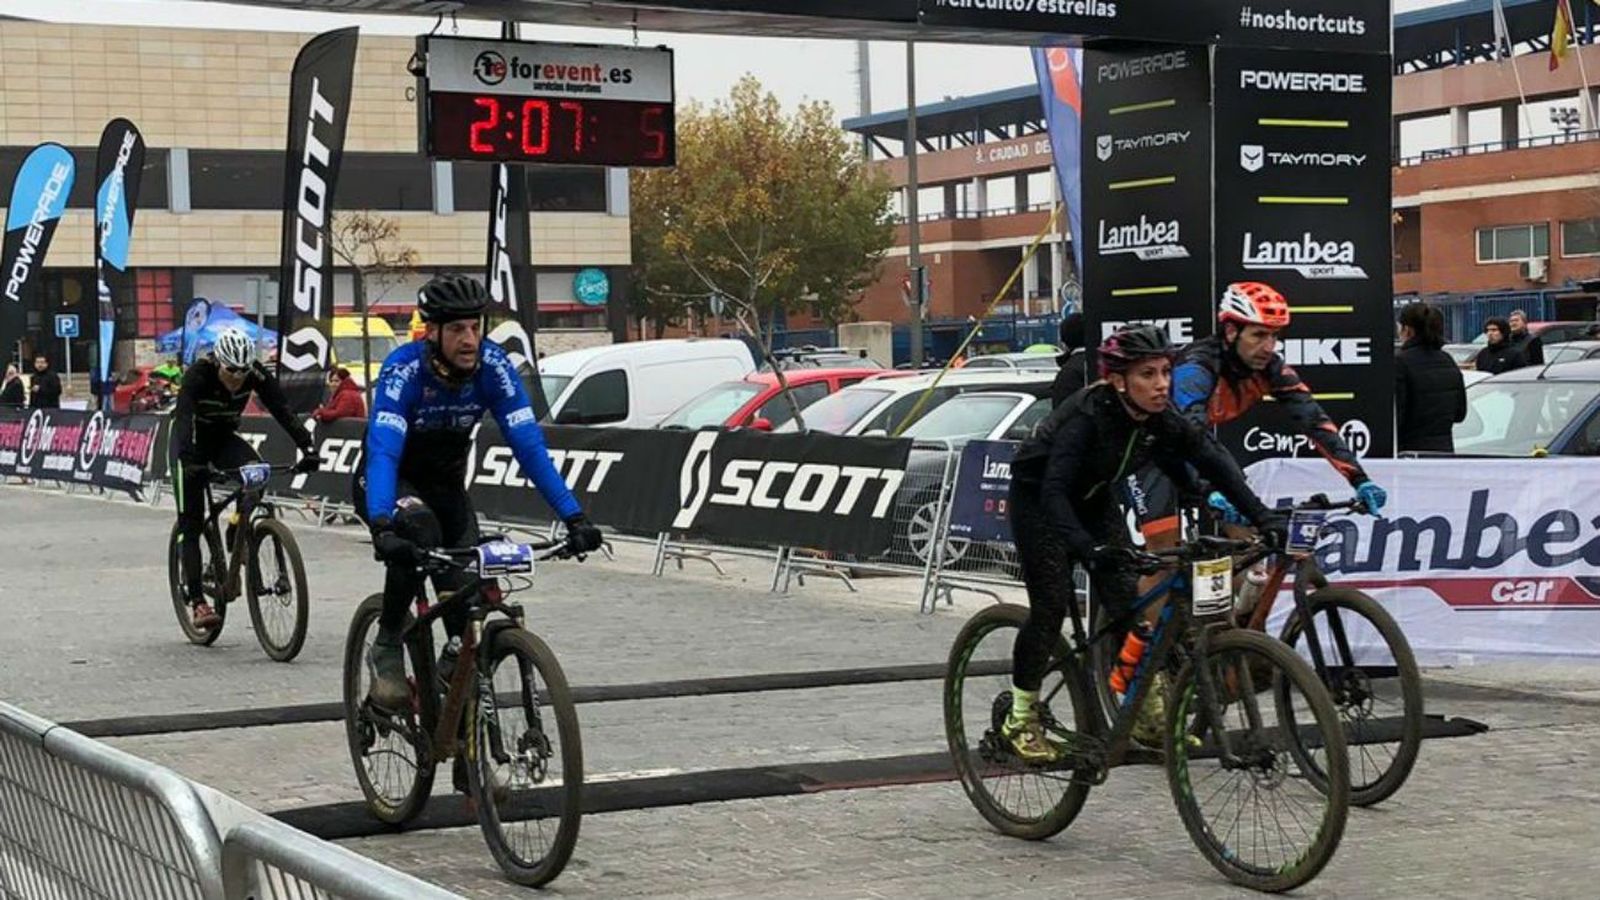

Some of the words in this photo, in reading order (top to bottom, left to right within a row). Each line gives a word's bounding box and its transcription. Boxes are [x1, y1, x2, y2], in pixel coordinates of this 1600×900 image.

[1240, 7, 1366, 35] #noshortcuts
[510, 56, 632, 84] forevent.es
[1099, 51, 1189, 83] POWERADE
[1241, 70, 1366, 93] POWERADE
[1115, 130, 1191, 150] TAYMORY
[1268, 152, 1367, 167] TAYMORY
[294, 77, 334, 320] SCOTT
[4, 161, 71, 302] POWERADE
[1098, 214, 1180, 250] Lambea
[1242, 232, 1354, 264] Lambea
[1309, 266, 1336, 276] sport
[62, 318, 73, 333] P
[983, 455, 1013, 479] Lam
[711, 459, 905, 518] SCOTT
[1491, 578, 1554, 602] car
